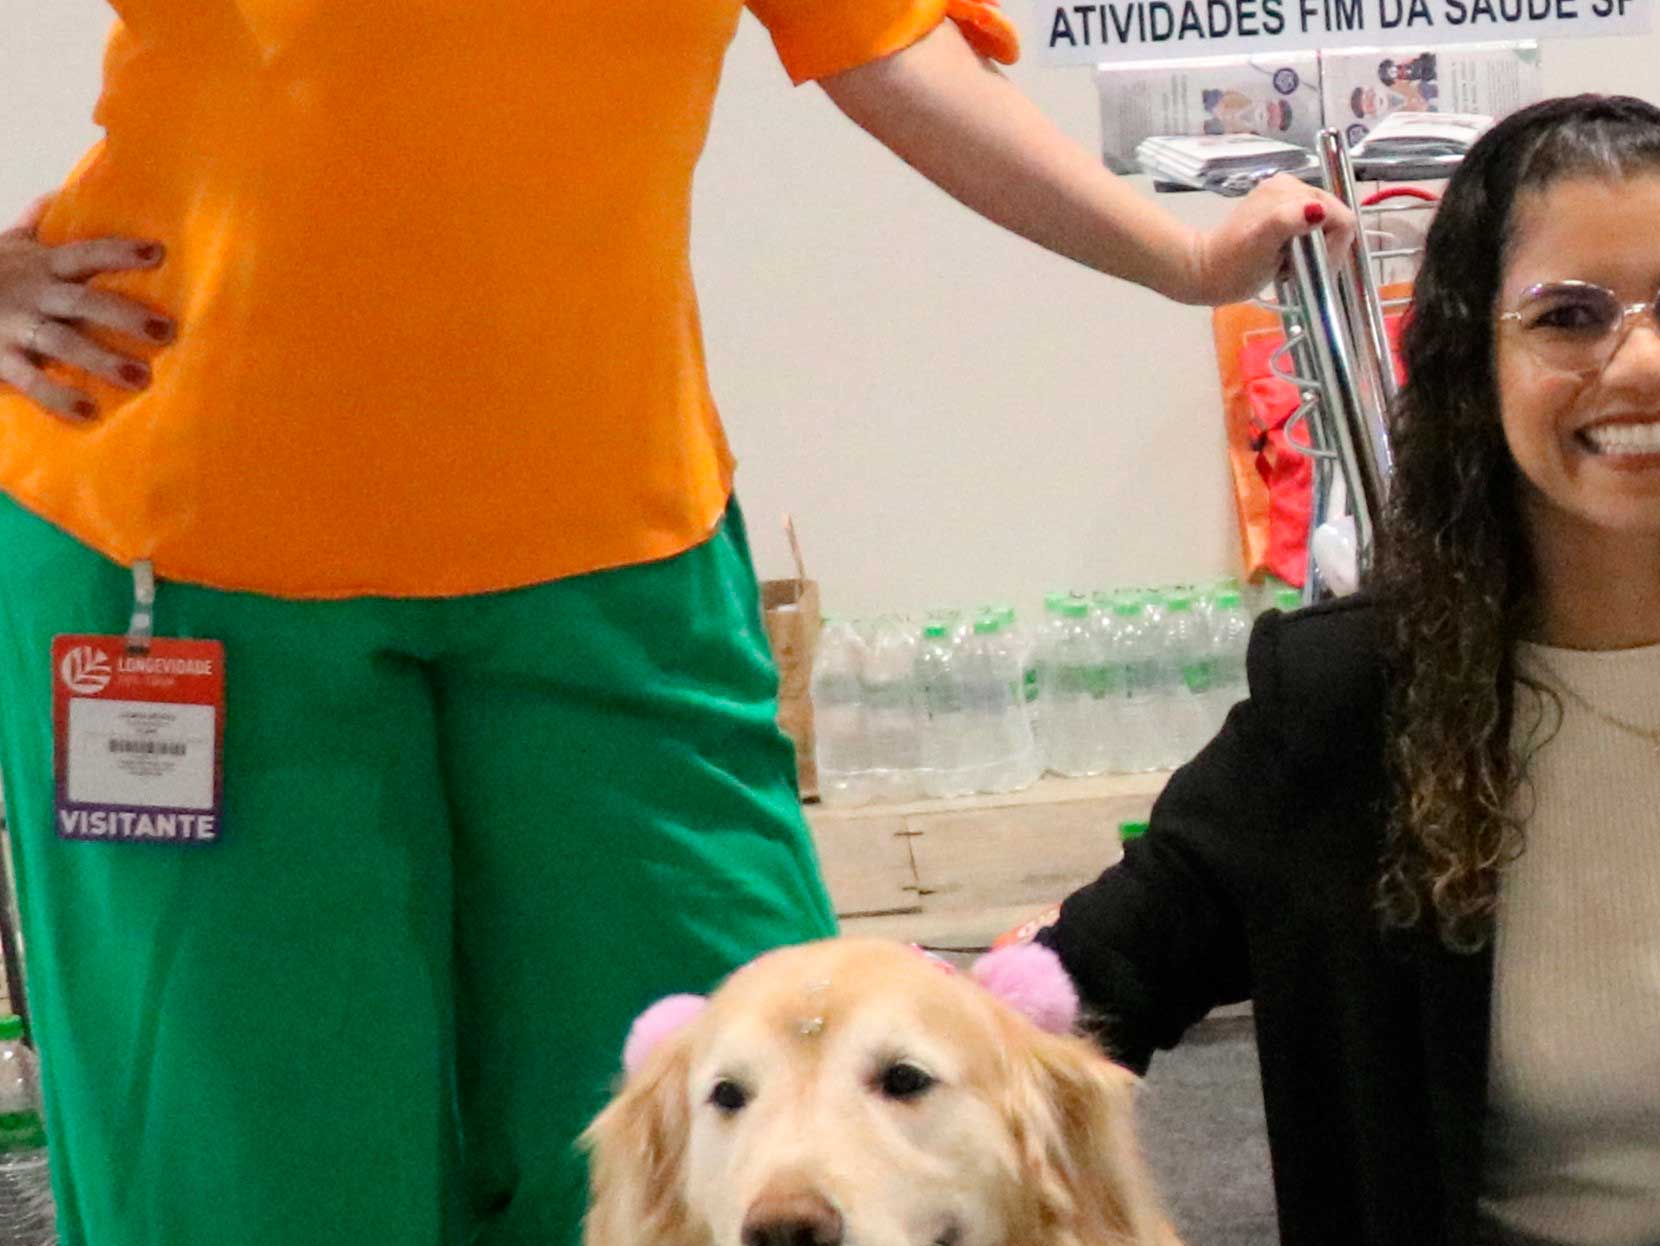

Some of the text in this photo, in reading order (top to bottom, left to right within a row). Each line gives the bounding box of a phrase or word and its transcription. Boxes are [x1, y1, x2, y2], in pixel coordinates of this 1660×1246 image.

[1050, 0, 1285, 47] ATIVIDADES
[1300, 0, 1364, 32] FIM
[1379, 0, 1433, 28] DA
[59, 809, 216, 839] VISITANTE
